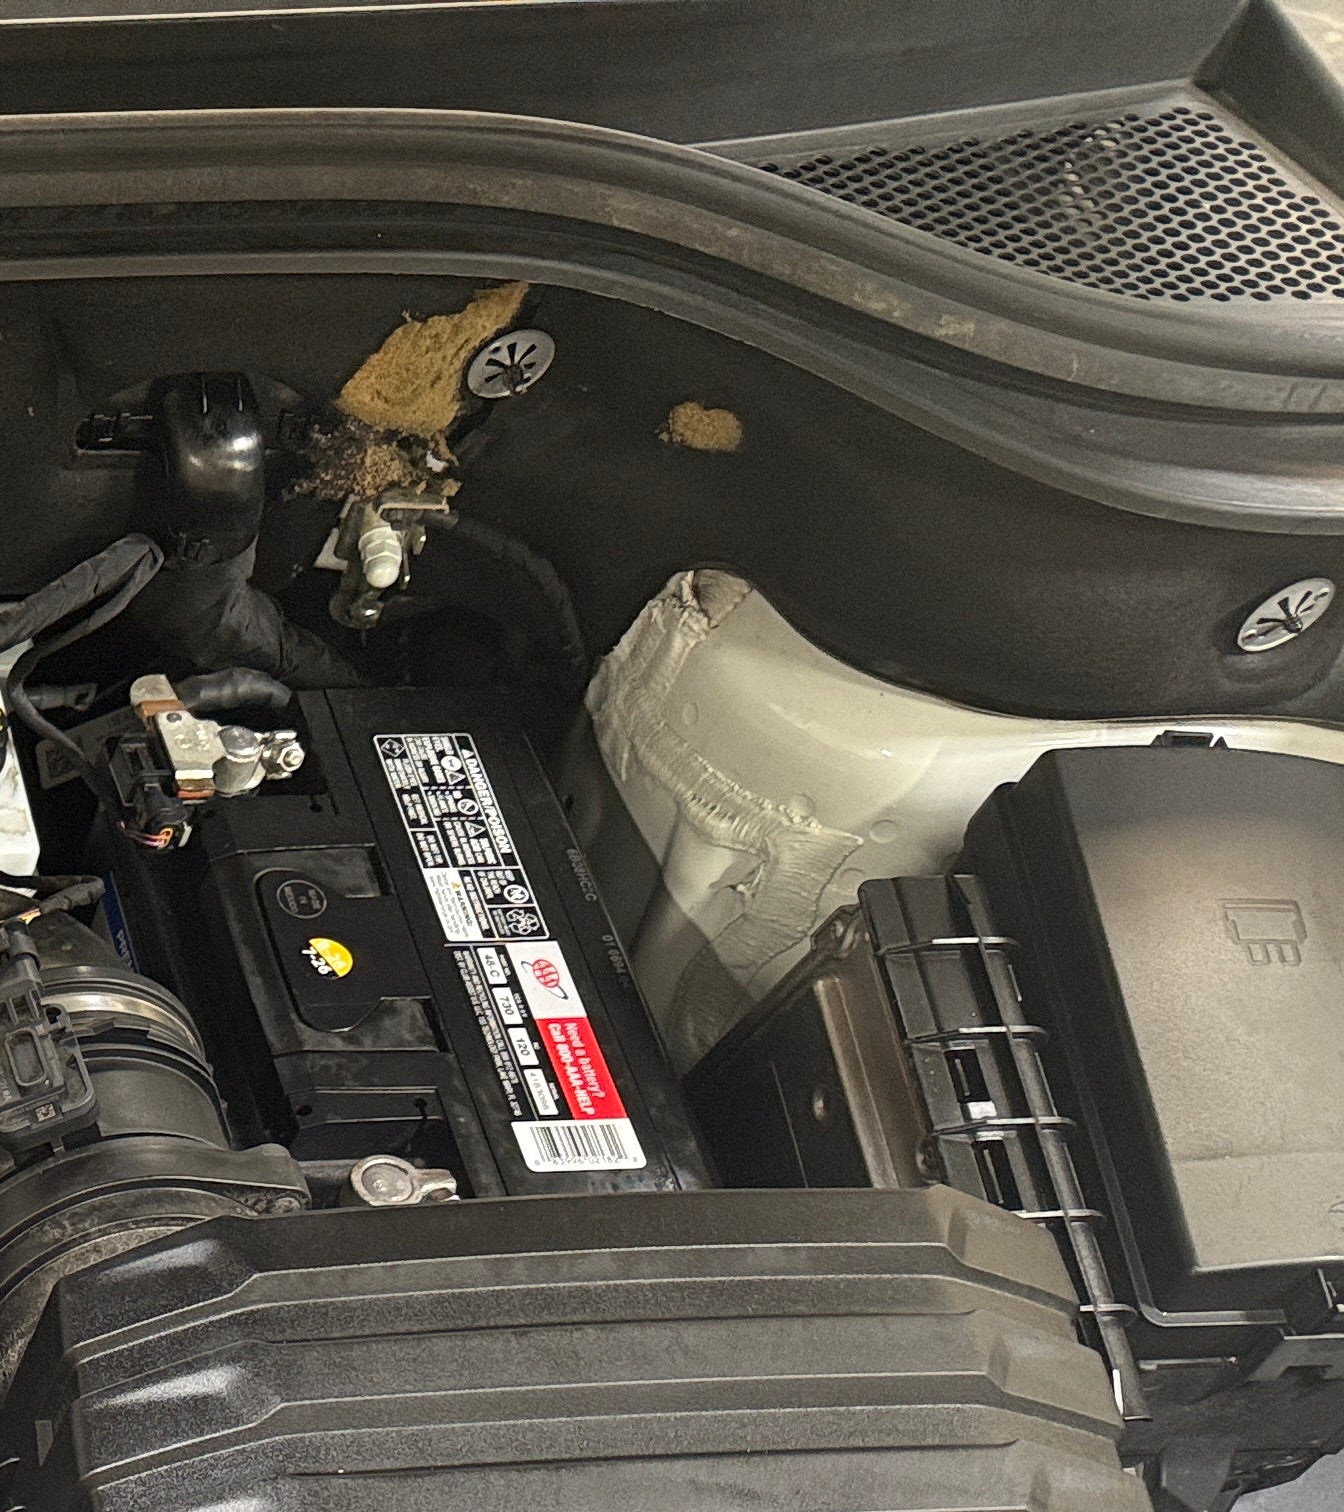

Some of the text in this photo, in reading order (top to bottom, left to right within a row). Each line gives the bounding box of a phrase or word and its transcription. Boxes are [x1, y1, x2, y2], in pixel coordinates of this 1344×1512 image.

[465, 759, 513, 854] DANGER/POISON
[499, 996, 515, 1016] 730
[515, 1037, 531, 1056] 120
[548, 1022, 596, 1116] Call 800-AAA-HELP
[565, 1022, 586, 1048] Need
[579, 1057, 606, 1099] battery?
